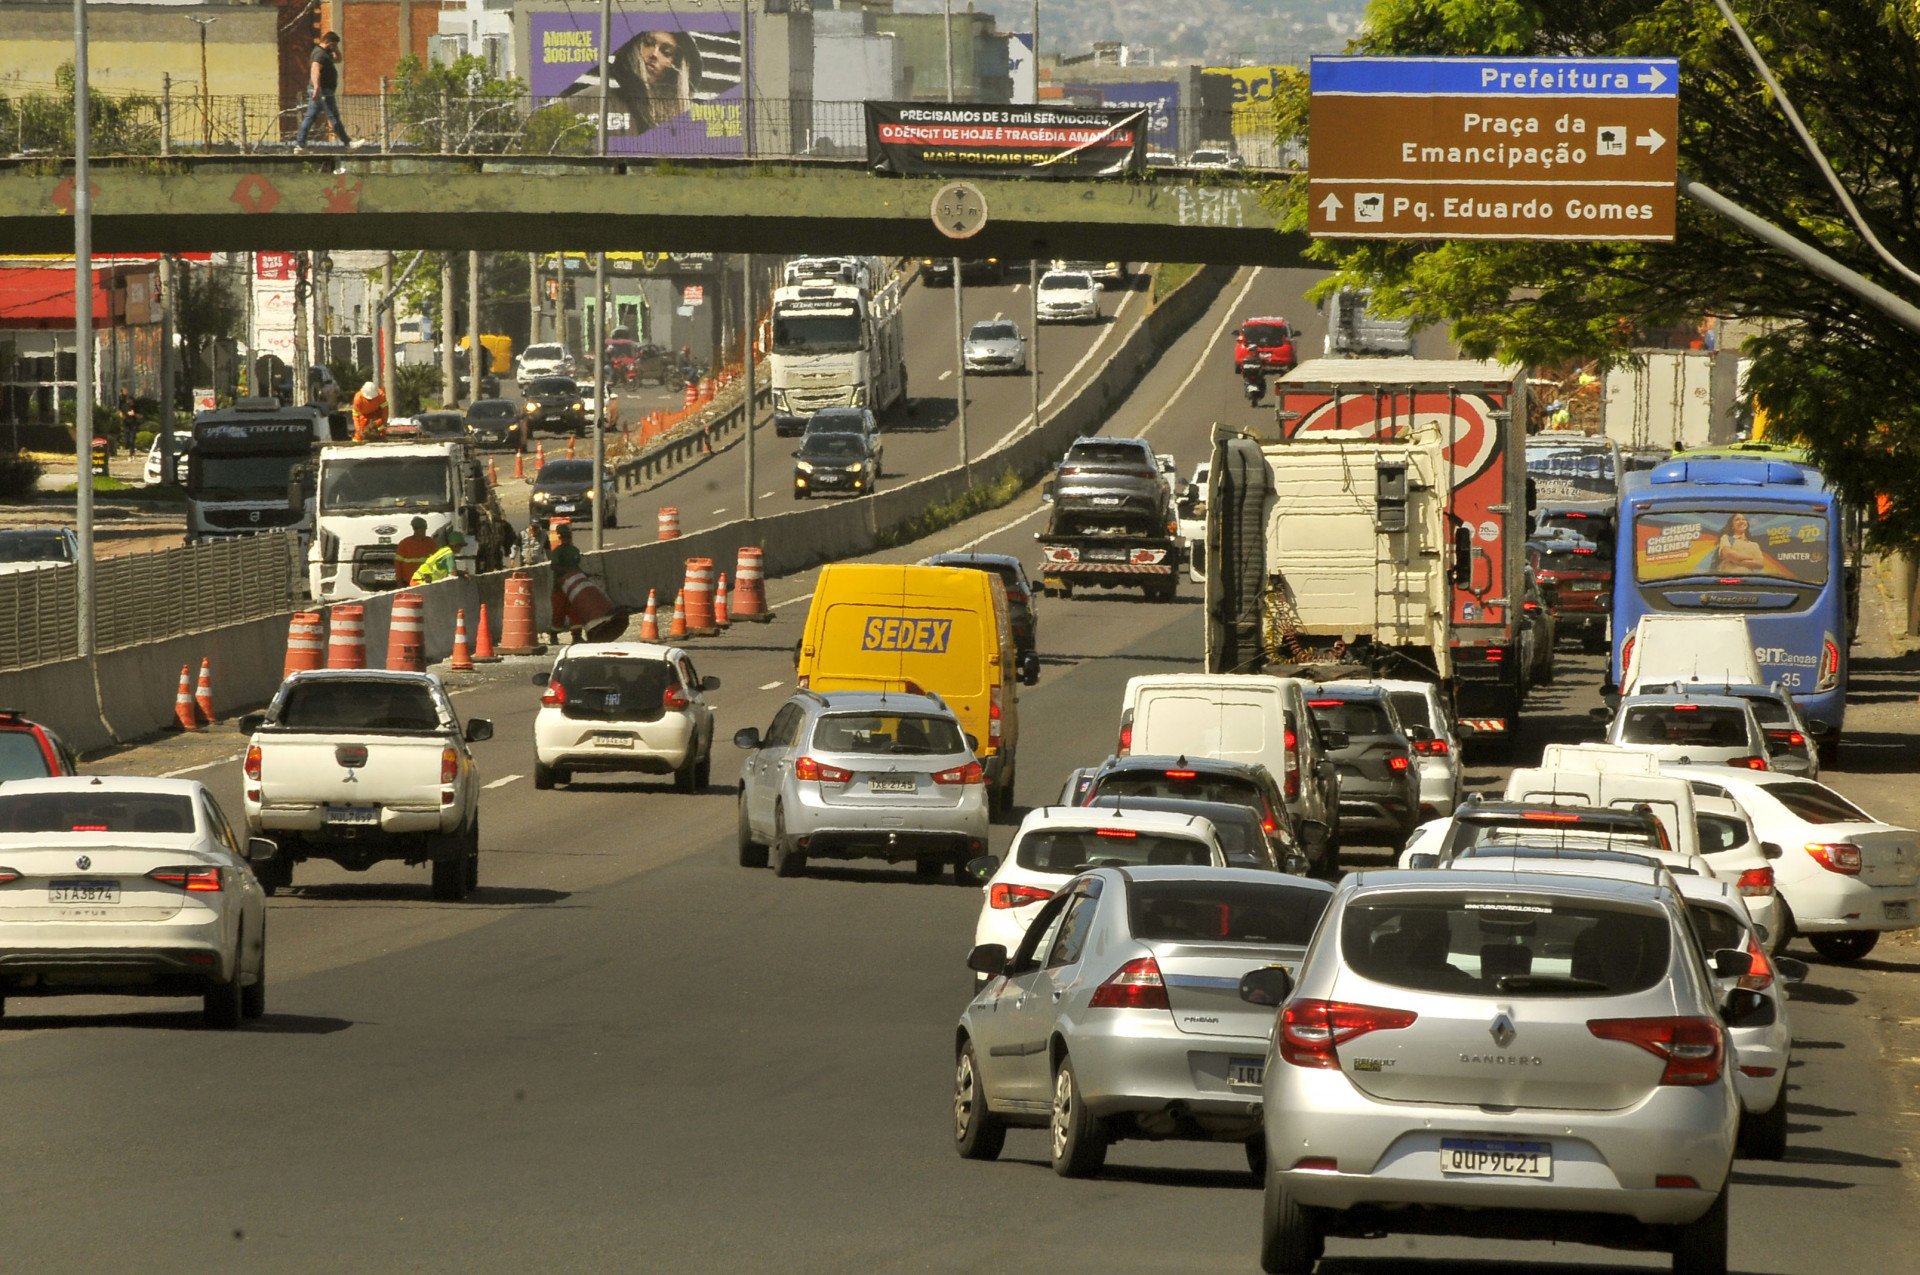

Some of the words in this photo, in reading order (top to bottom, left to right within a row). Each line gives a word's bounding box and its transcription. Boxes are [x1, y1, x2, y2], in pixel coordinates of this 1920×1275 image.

[1481, 68, 1629, 89] Prefeitura
[900, 110, 980, 122] PRECISAMOS
[982, 112, 999, 122] DE
[1001, 112, 1009, 122] 3
[1011, 112, 1031, 123] mil
[1033, 112, 1112, 126] SERVIDORES,
[1464, 113, 1538, 137] Praça
[1555, 114, 1586, 133] da
[883, 127, 893, 137] O
[895, 125, 940, 139] DÉFICIT
[943, 128, 958, 139] DE
[960, 129, 993, 140] HOJE
[1005, 126, 1066, 141] TRAGÉDIA
[923, 151, 957, 161] MAIS
[958, 152, 1021, 164] POLICIAIS
[1402, 143, 1587, 168] Emancipação
[1393, 198, 1434, 222] Pq.
[1443, 198, 1553, 219] Eduardo
[1566, 200, 1653, 220] Gomes
[1662, 523, 1701, 536] CHEGUE
[1647, 531, 1700, 546] CHEGANDO
[1648, 544, 1662, 554] NO
[864, 618, 950, 651] SEDEX
[1782, 673, 1801, 687] 35
[54, 887, 112, 900] STA3B74
[1461, 1055, 1543, 1066] SANDERO
[1452, 1150, 1539, 1173] QUP9C21
